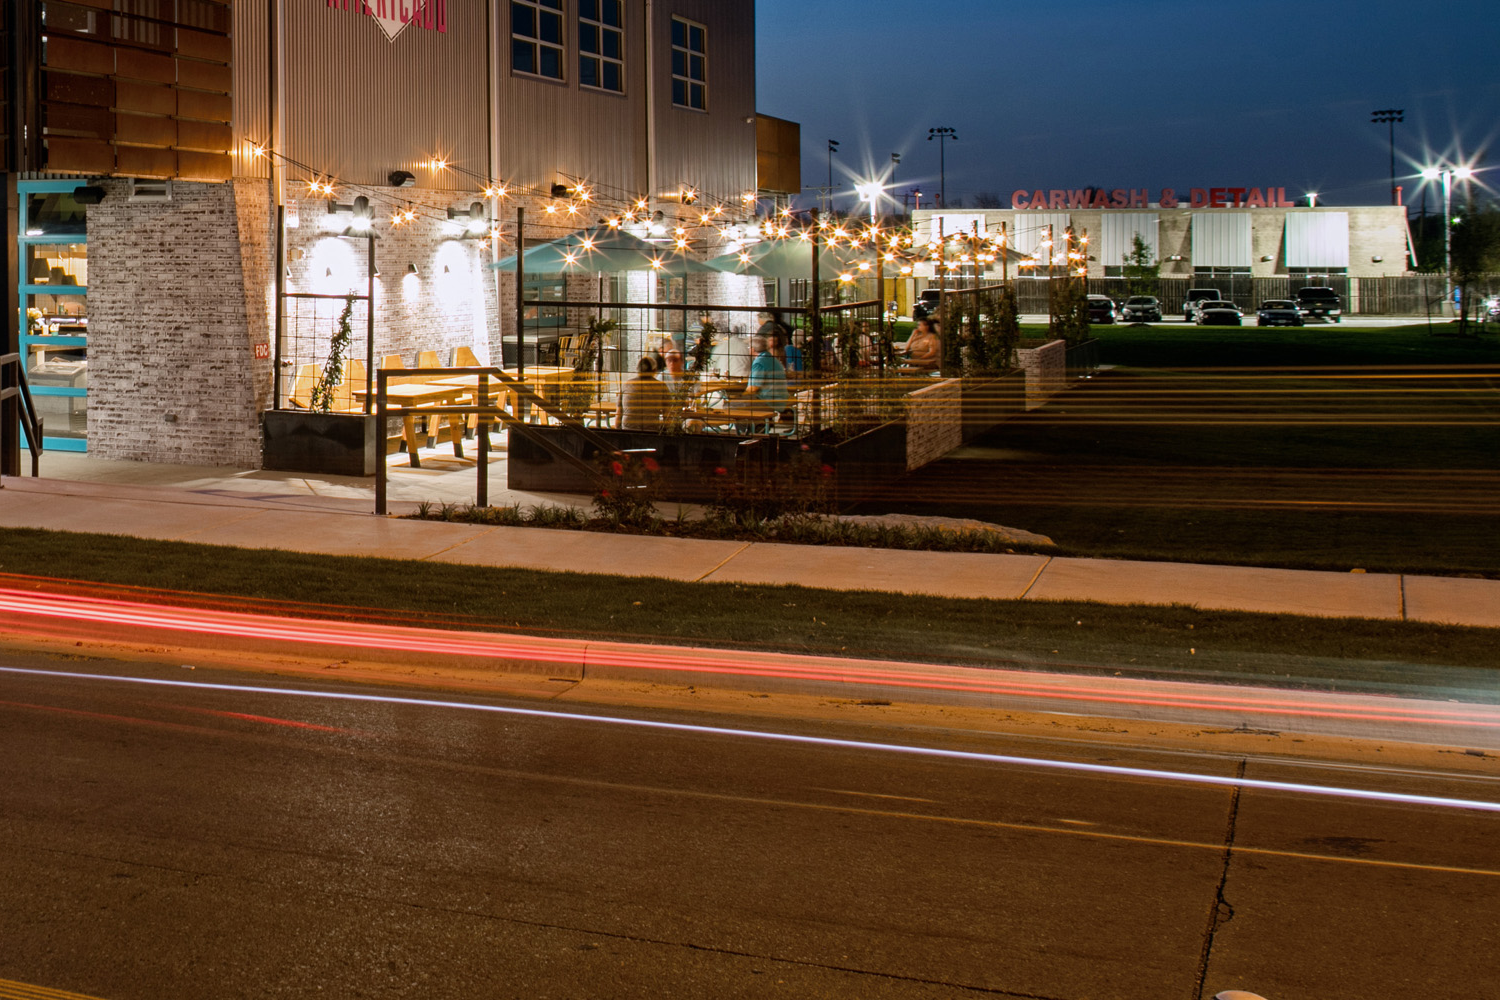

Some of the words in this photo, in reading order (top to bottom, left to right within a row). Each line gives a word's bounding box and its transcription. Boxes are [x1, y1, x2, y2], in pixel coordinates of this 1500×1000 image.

[1012, 189, 1148, 209] CARWASH
[1160, 188, 1180, 208] &
[1190, 187, 1294, 208] DETAIL
[255, 344, 268, 358] FDC
